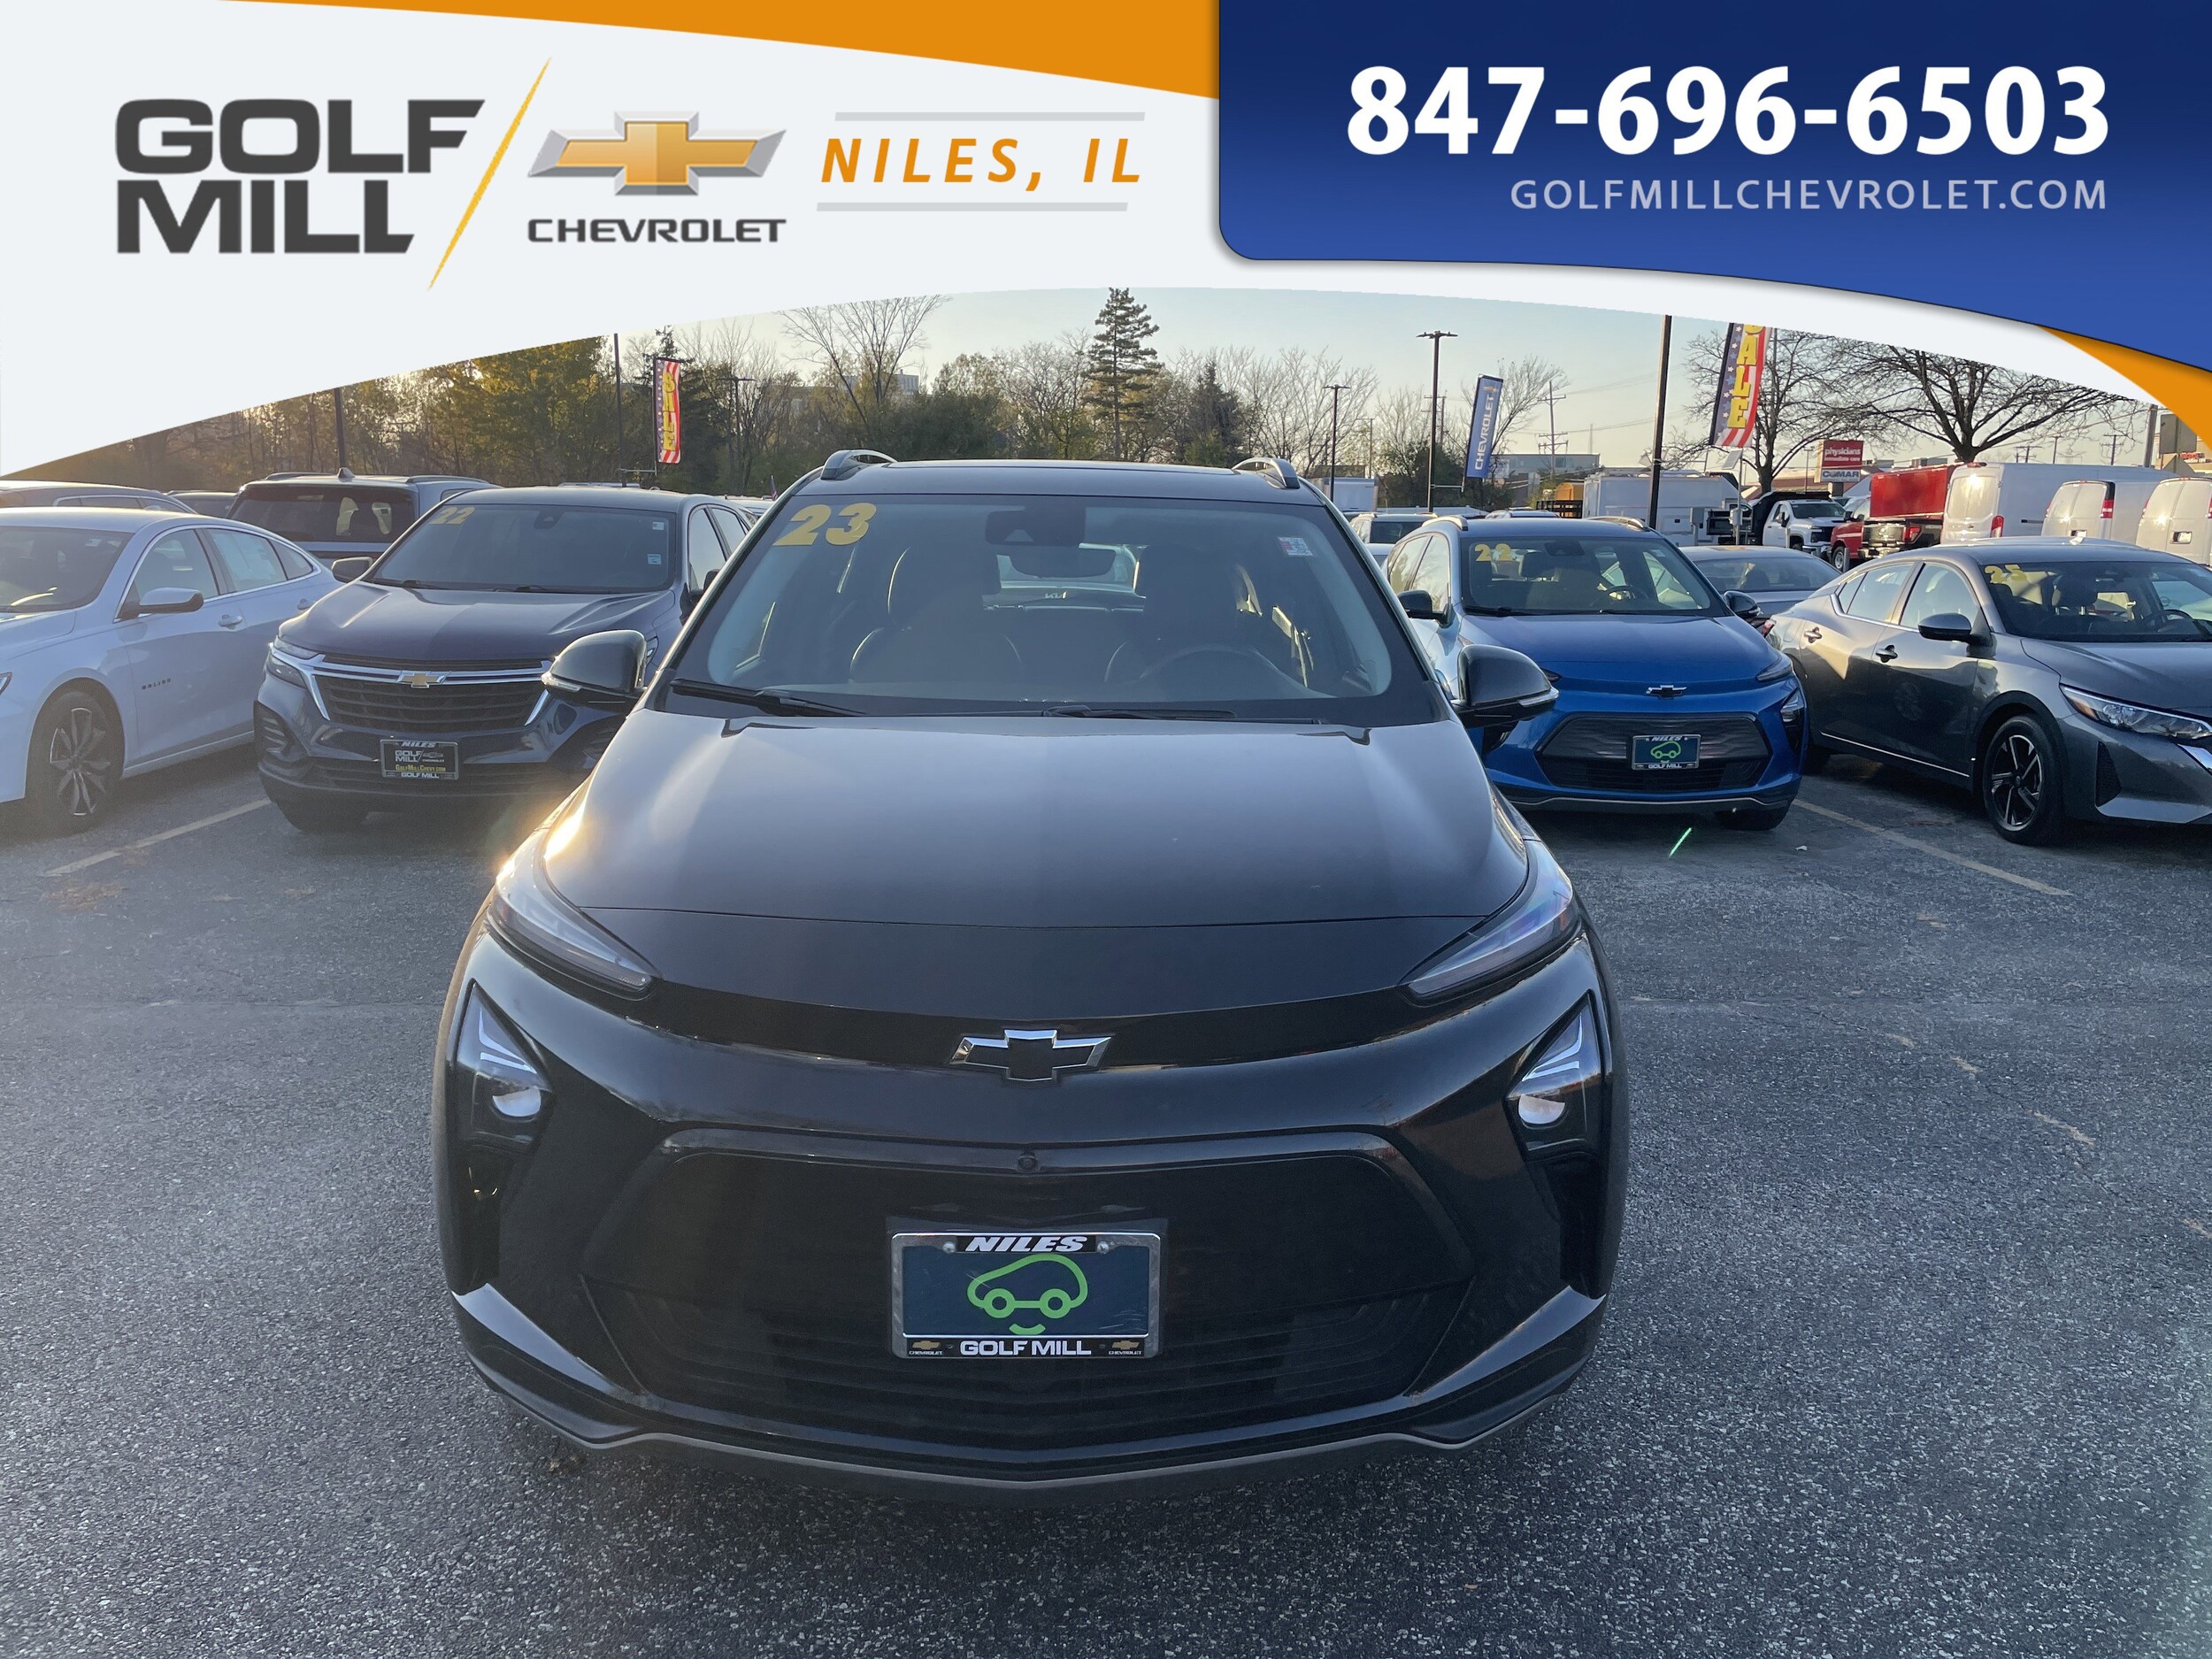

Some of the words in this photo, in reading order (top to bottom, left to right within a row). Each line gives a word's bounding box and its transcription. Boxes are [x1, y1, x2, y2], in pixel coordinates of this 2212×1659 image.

[661, 370, 676, 451] SALE
[1474, 394, 1494, 471] CHEVROLET
[1824, 446, 1862, 457] physicians
[429, 506, 475, 525] 22
[772, 502, 877, 547] 23
[1474, 542, 1513, 562] 22
[964, 1235, 1088, 1253] NILES
[959, 1340, 1028, 1356] GOLF
[1031, 1340, 1092, 1356] MILL
